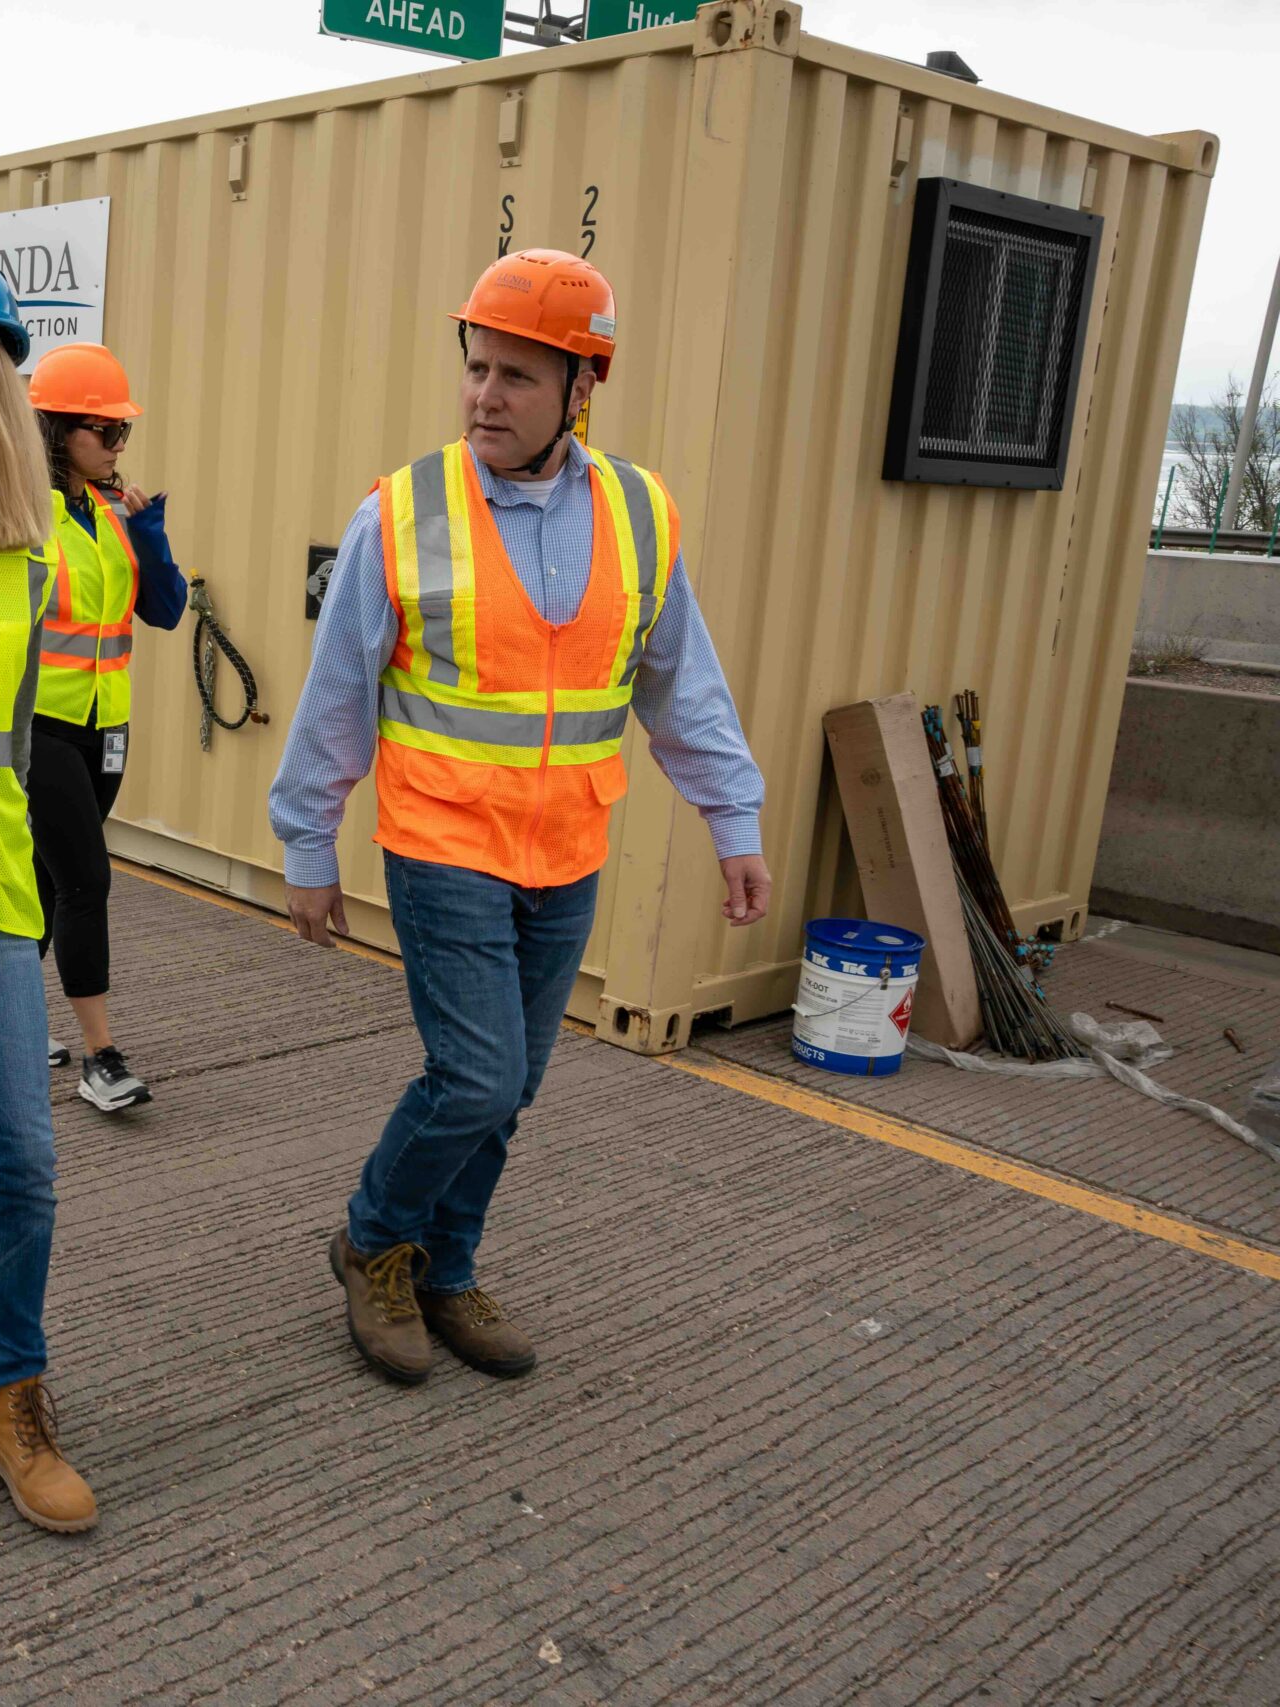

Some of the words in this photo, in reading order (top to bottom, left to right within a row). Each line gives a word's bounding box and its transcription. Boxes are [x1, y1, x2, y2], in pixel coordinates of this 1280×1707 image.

[365, 0, 465, 40] AHEAD
[627, 1, 687, 30] Hud
[19, 317, 78, 337] CTION
[840, 960, 868, 976] TK
